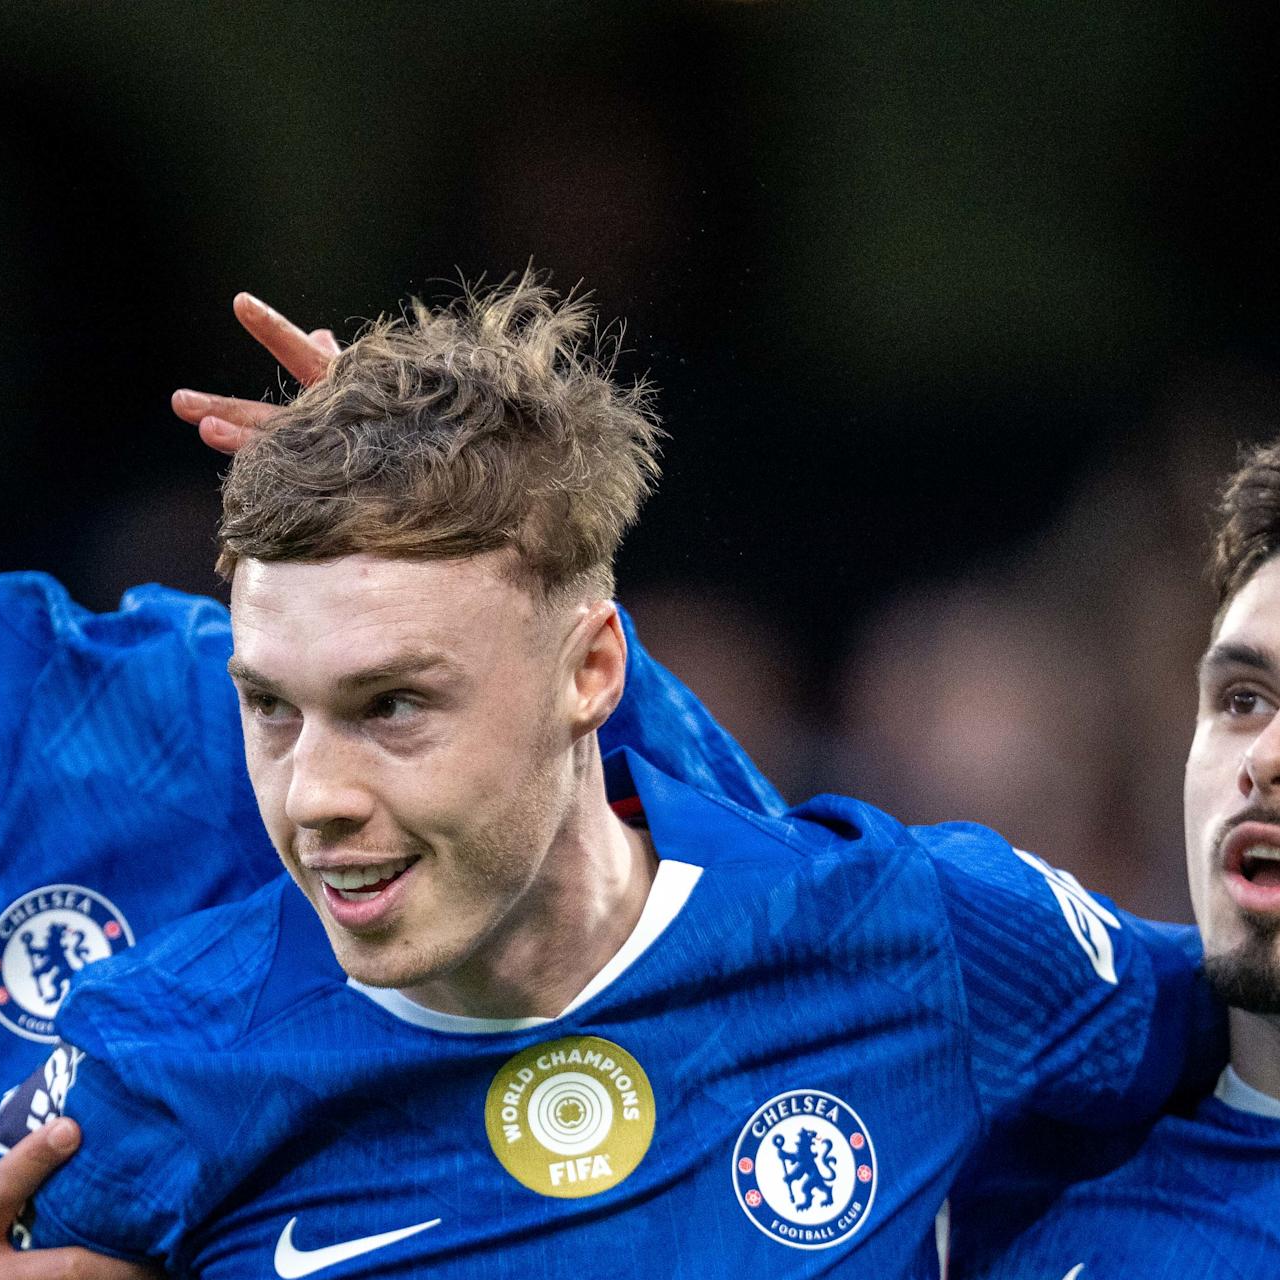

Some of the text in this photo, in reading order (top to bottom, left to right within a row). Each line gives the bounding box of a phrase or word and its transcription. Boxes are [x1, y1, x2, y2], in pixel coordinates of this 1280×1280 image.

[501, 1049, 641, 1144] WORLD CHAMPIONS
[751, 1095, 840, 1138] CHELSEA
[548, 1154, 613, 1186] FIFA
[771, 1201, 863, 1241] FOOTBALL CLUB
